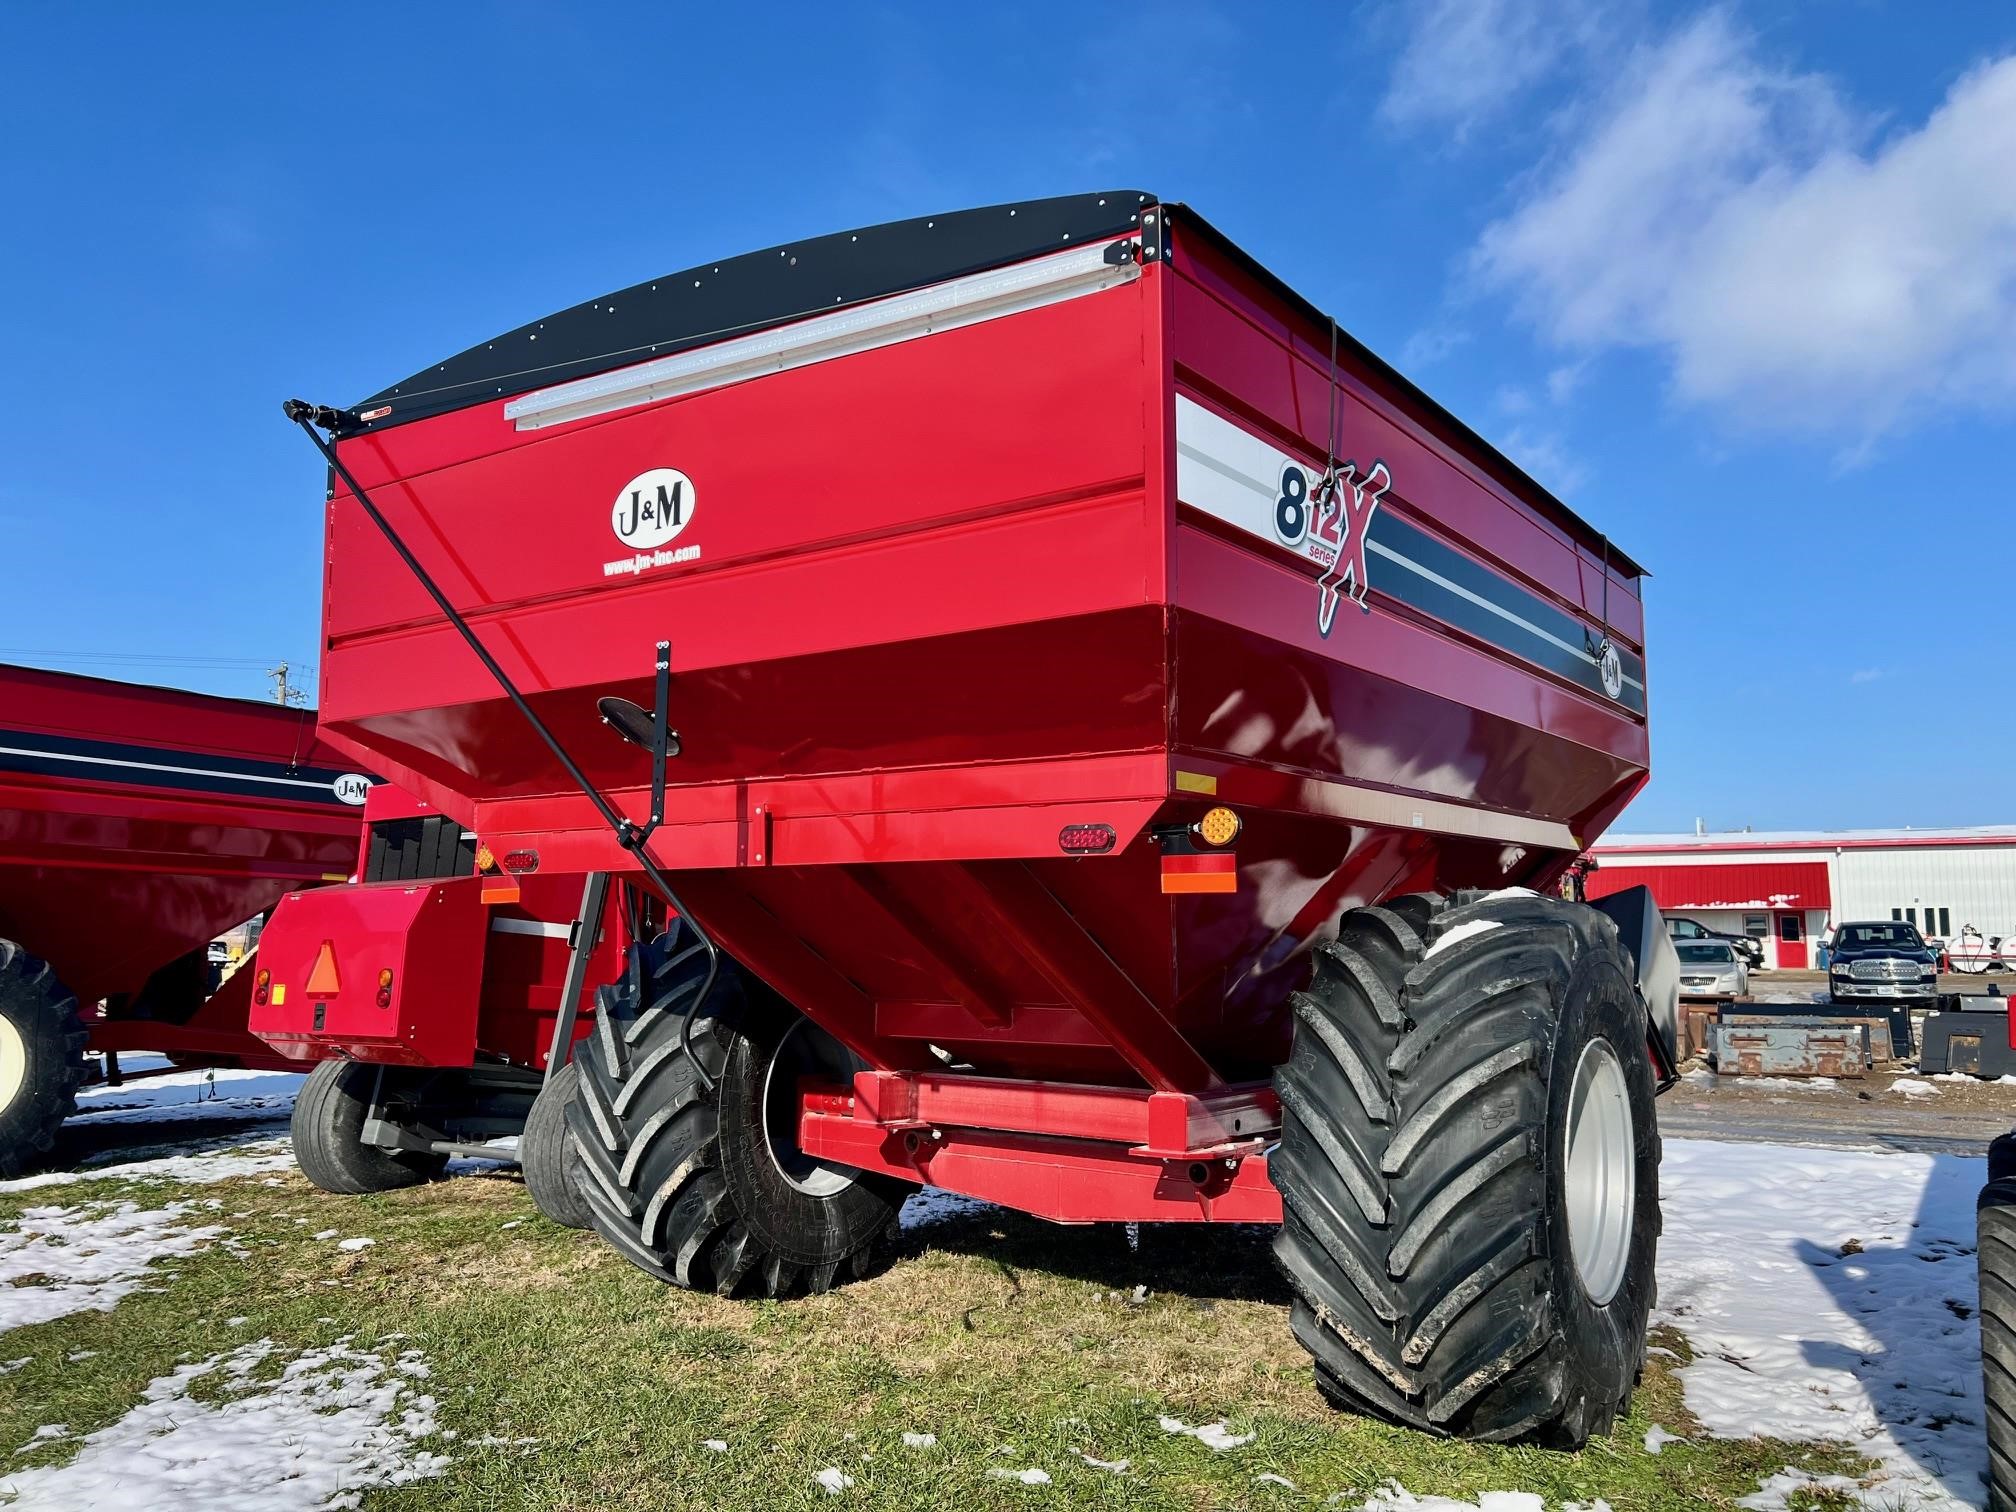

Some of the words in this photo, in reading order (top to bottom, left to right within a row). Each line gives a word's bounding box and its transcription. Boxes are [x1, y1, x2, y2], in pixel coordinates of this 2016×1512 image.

[618, 480, 684, 537] J&M
[603, 544, 701, 577] www.jm-inc.com
[1308, 544, 1336, 567] series
[338, 780, 368, 799] J&M
